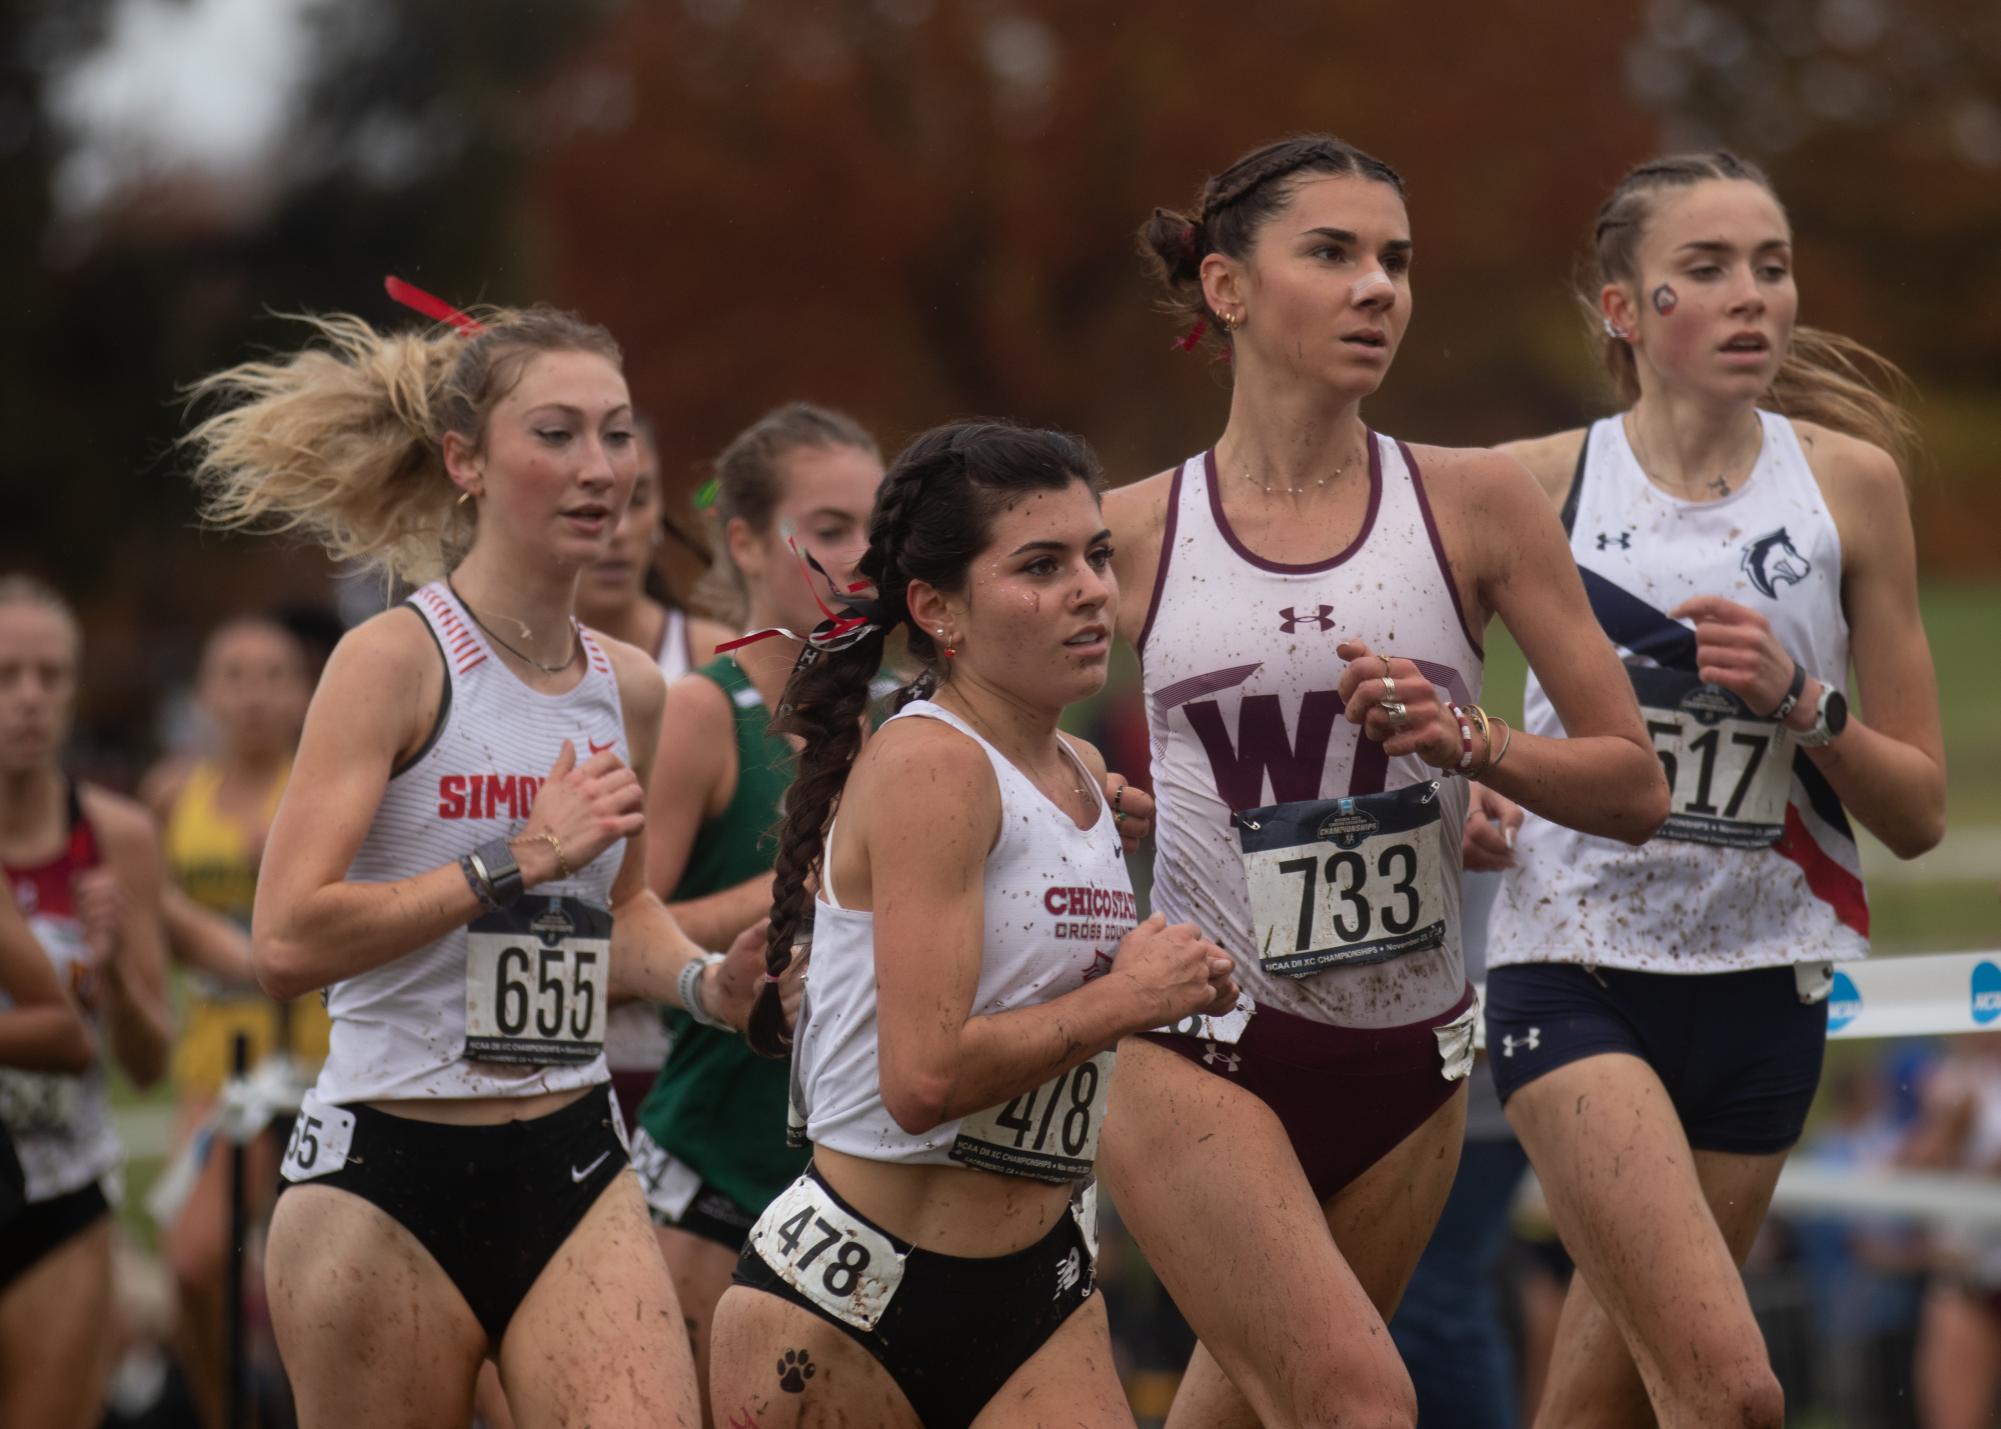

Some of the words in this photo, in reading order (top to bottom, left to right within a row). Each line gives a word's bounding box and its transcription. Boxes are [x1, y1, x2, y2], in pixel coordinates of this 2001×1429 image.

[439, 774, 545, 820] SIMO
[1043, 886, 1112, 919] CHICO
[1279, 844, 1421, 953] 733
[1055, 922, 1102, 940] CROSS
[1317, 946, 1379, 964] CHAMPIONSHIPS
[495, 946, 598, 1041] 655
[778, 1205, 872, 1298] 478
